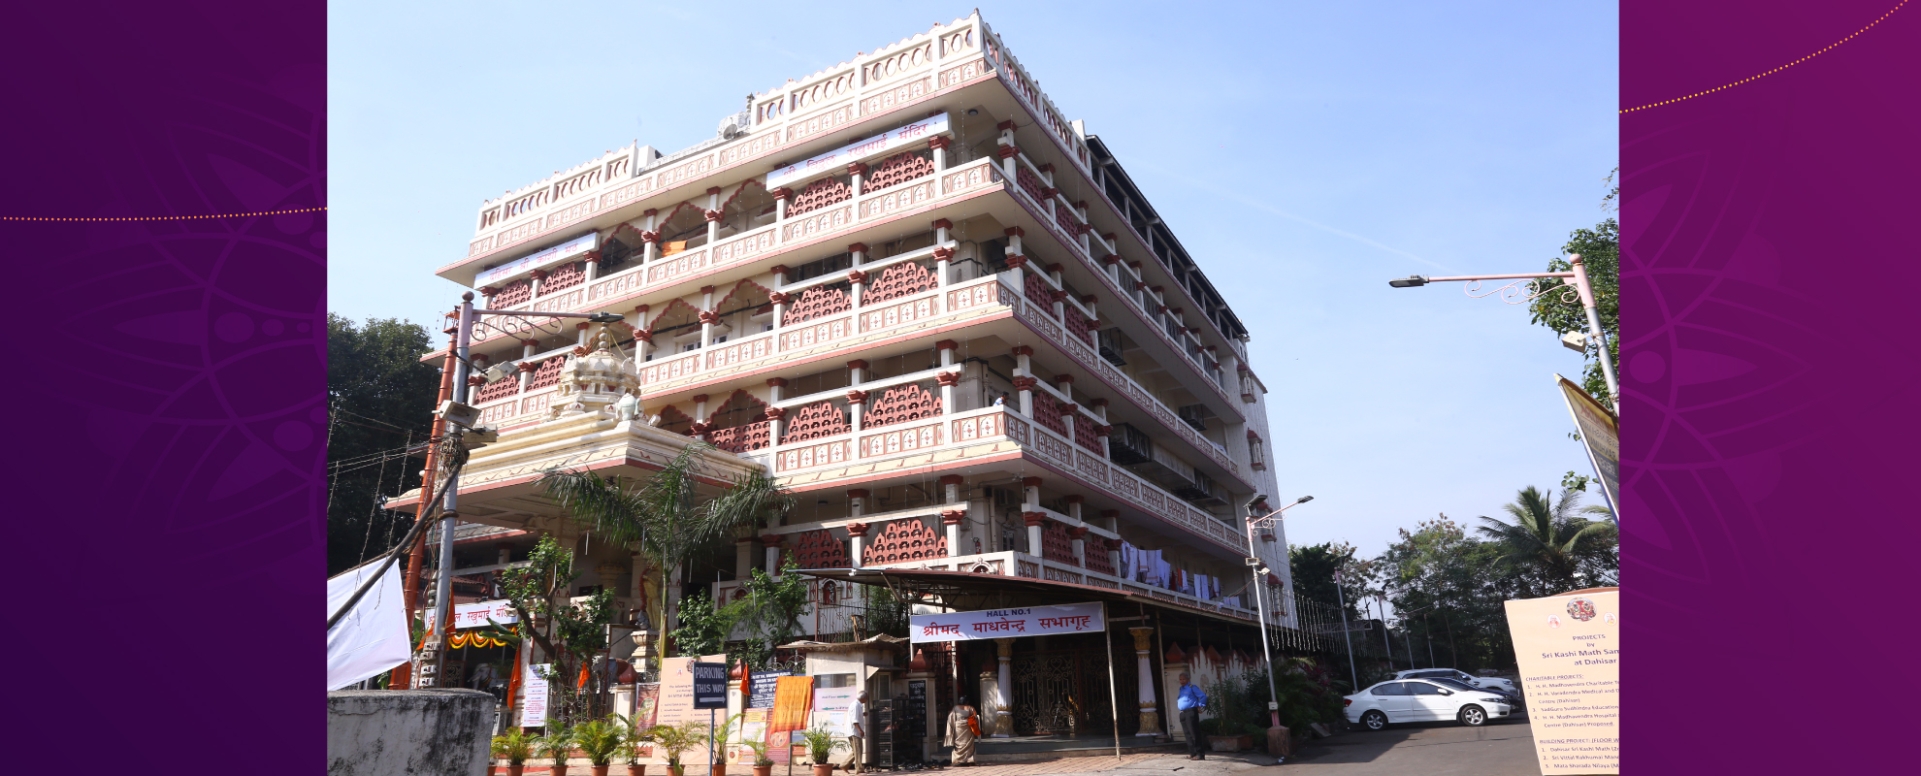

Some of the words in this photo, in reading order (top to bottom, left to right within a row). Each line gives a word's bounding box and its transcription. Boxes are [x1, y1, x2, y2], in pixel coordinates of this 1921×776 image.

[898, 122, 929, 139] मंदिर
[986, 609, 1009, 617] HALL
[1011, 608, 1031, 616] NO.1
[972, 617, 1026, 633] माधवेन्द्र
[1038, 615, 1091, 631] सभागृह
[1554, 650, 1577, 658] Kashi
[1584, 658, 1617, 666] Dahisar
[695, 666, 725, 679] PARKING
[696, 683, 711, 693] THIS
[711, 683, 725, 693] WAY
